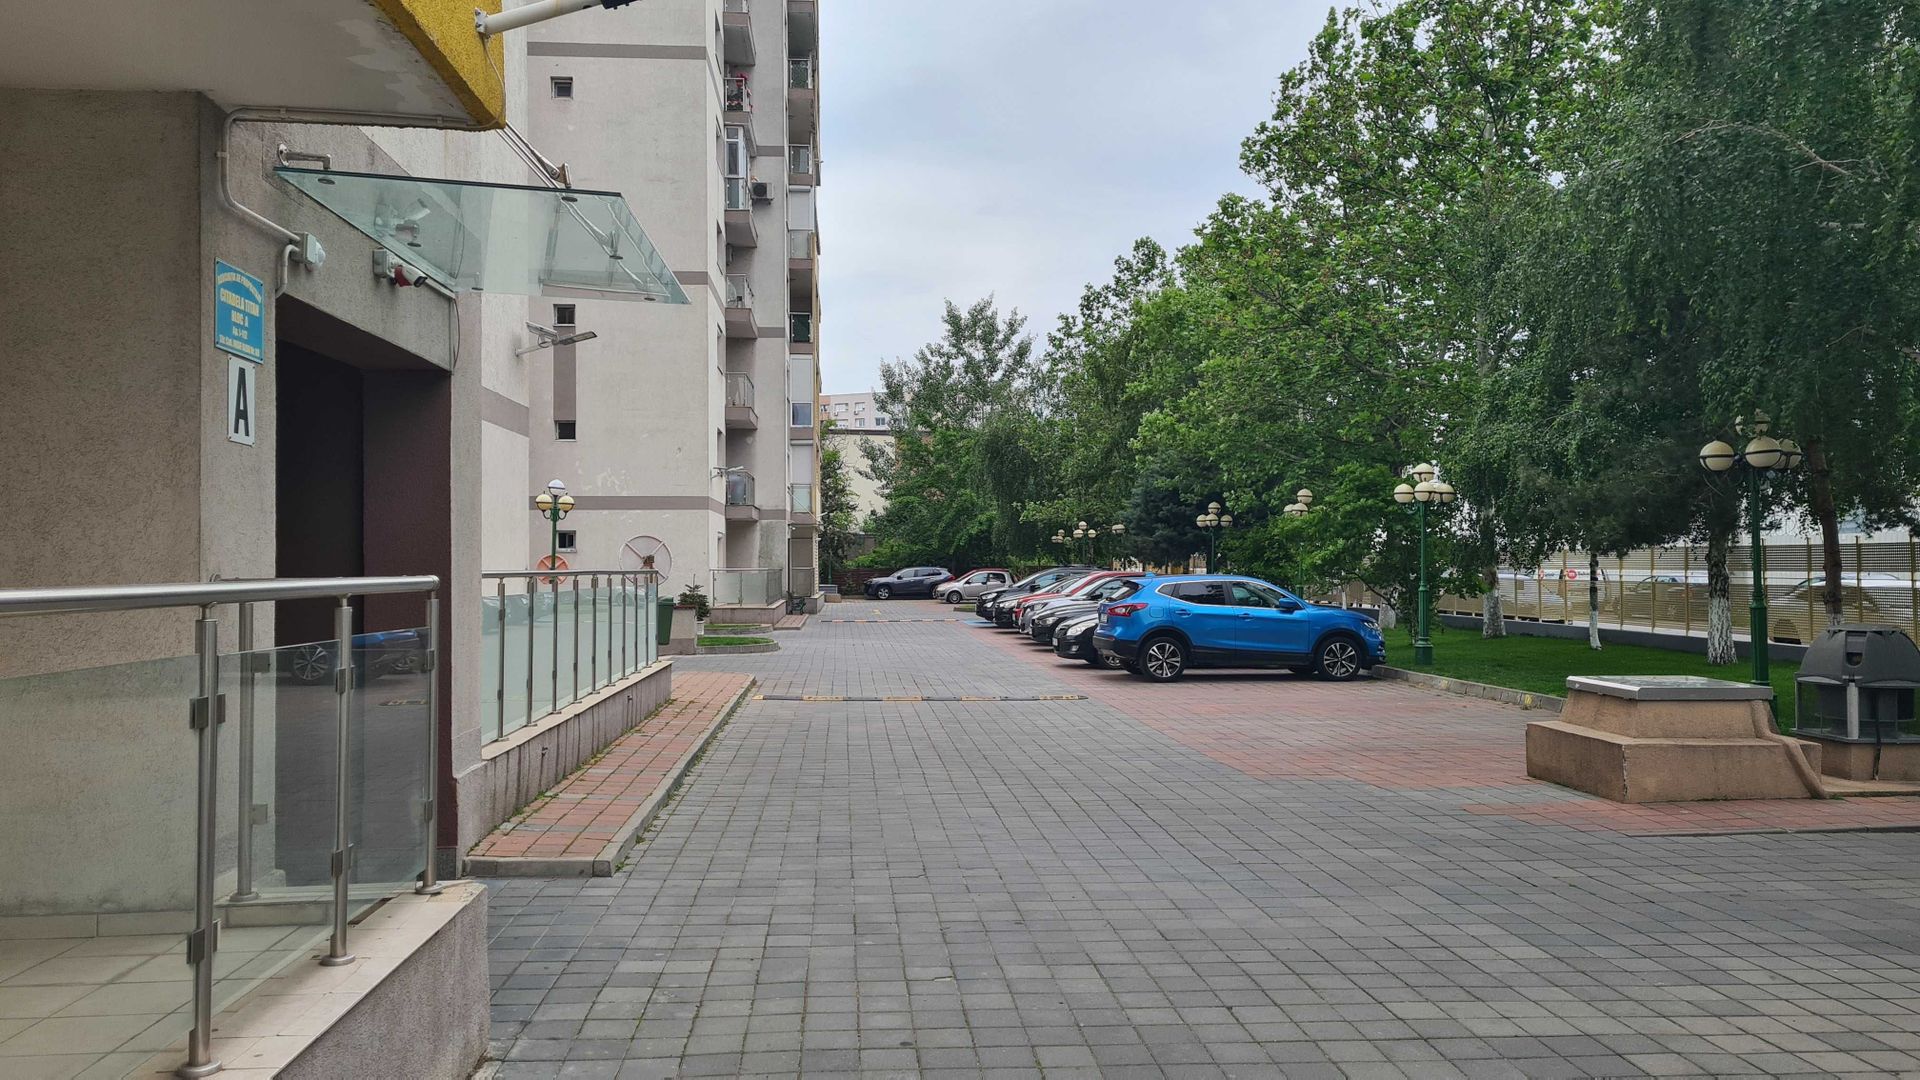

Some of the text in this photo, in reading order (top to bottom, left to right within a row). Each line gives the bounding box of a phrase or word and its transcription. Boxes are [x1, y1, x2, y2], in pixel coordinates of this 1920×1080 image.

[220, 288, 244, 311] CITADELA
[245, 299, 260, 317] TITAN
[233, 366, 250, 437] A
